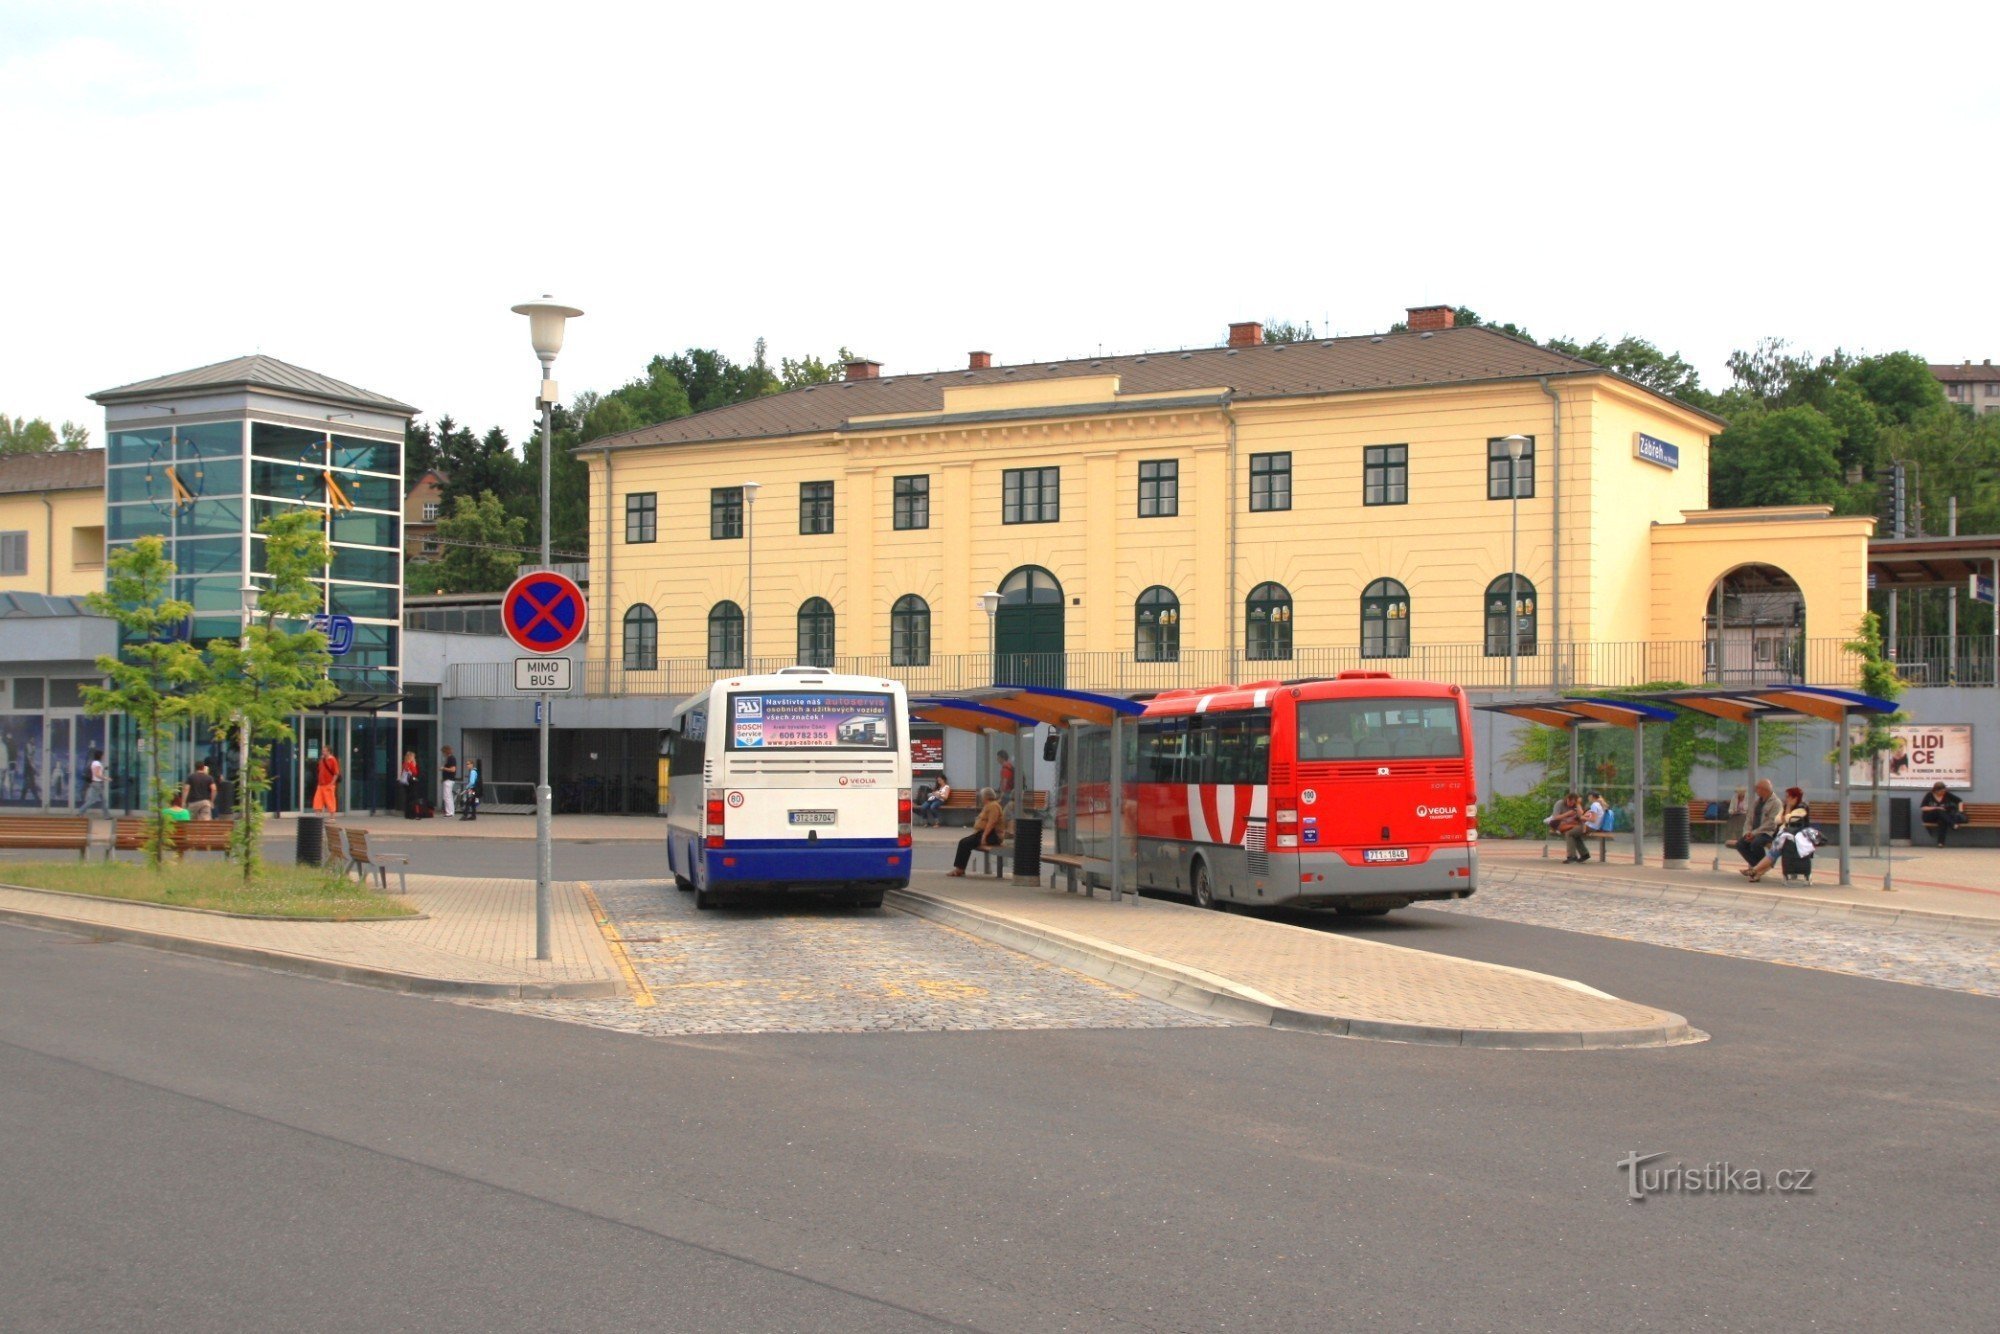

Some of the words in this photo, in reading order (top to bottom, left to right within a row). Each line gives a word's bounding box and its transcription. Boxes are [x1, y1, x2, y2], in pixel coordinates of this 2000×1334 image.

[1640, 437, 1664, 460] Zábřeh
[527, 662, 559, 672] MIMO
[531, 675, 555, 686] BUS
[806, 697, 821, 706] náš
[824, 698, 885, 706] autoservis
[812, 706, 855, 714] užitkových
[1912, 735, 1944, 748] LIDI
[1912, 751, 1935, 764] CE
[731, 795, 741, 803] 80
[1303, 790, 1315, 799] 100
[1428, 806, 1457, 814] VEOLIA
[796, 814, 809, 822] 3T2
[1369, 851, 1383, 859] 7T1
